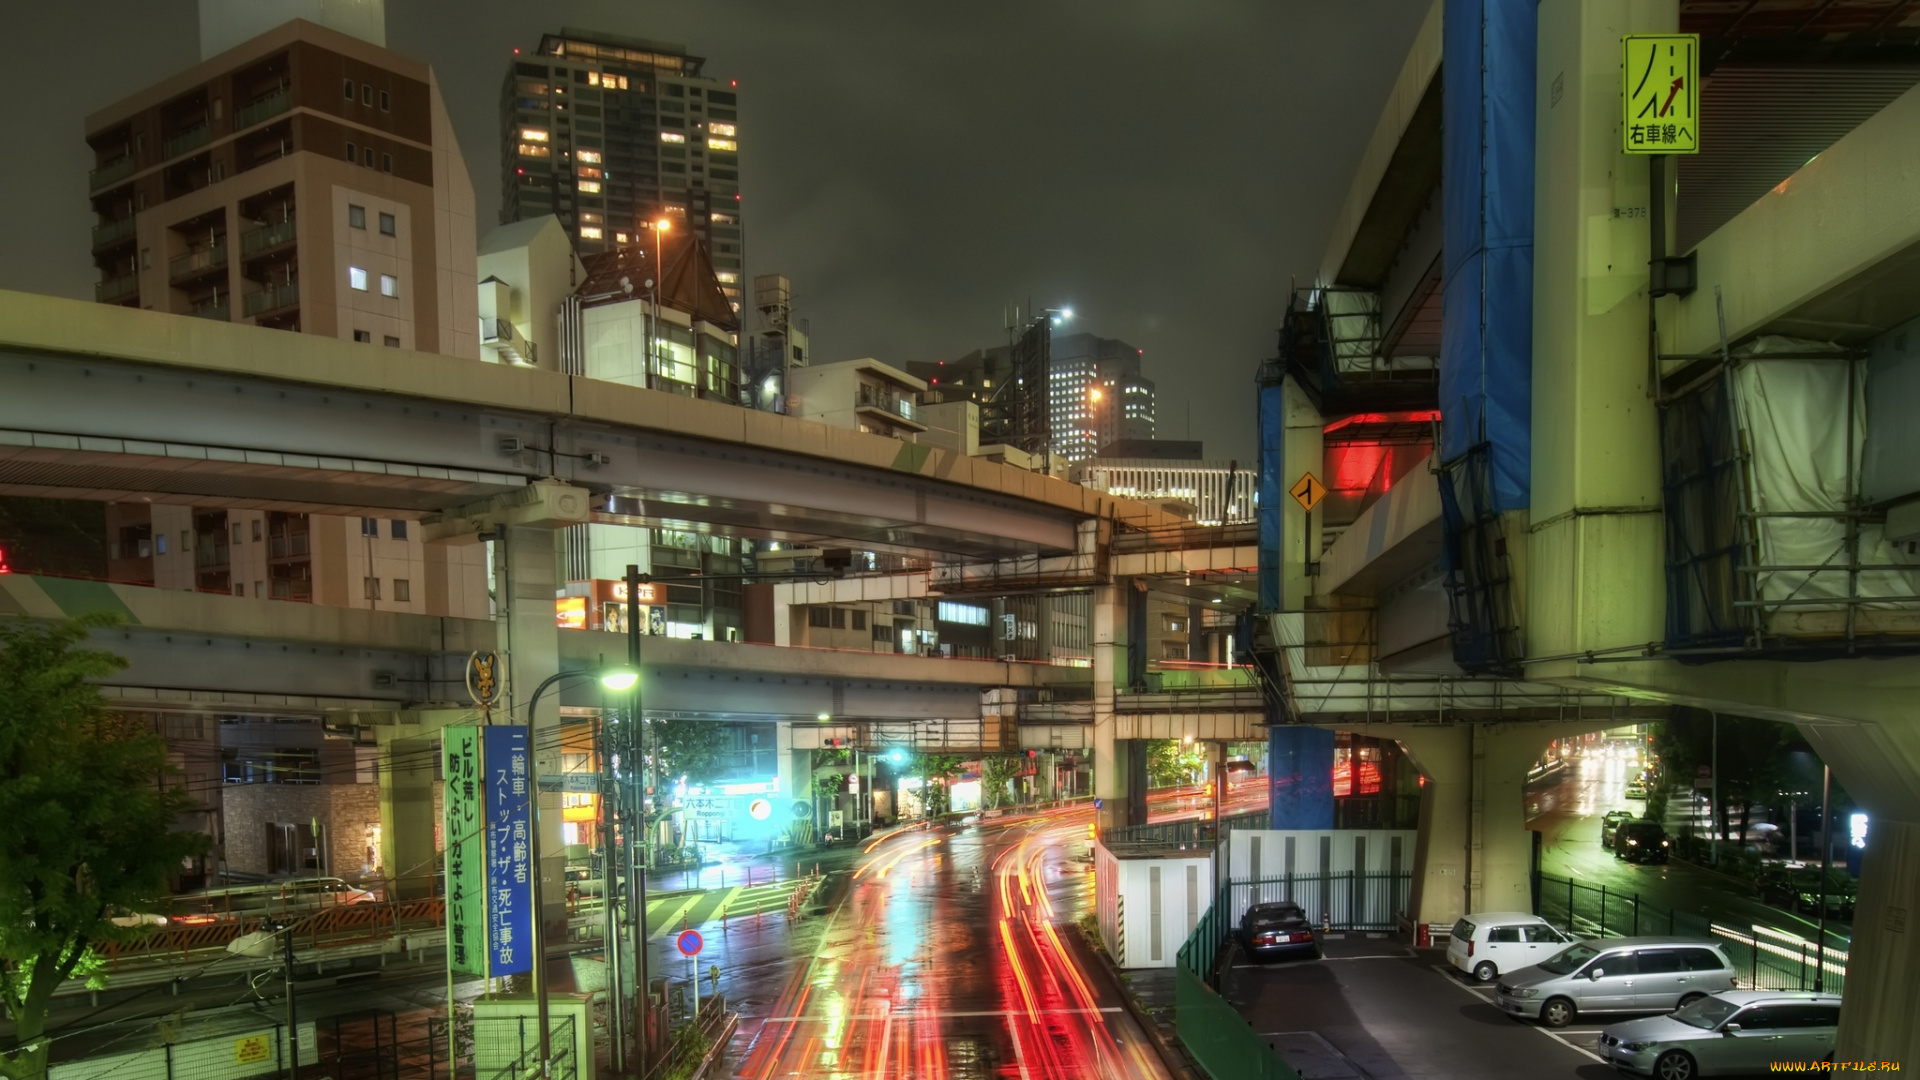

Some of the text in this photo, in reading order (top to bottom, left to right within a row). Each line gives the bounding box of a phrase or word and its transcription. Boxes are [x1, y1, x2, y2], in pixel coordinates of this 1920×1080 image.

[1630, 123, 1693, 145] 右車線へ
[462, 736, 474, 822] ビル荒し
[511, 734, 528, 884] 二輪車・高齢者
[449, 753, 466, 965] 防ぐよいカギよい管理
[496, 769, 514, 965] ストップ・ザ・死亡事故
